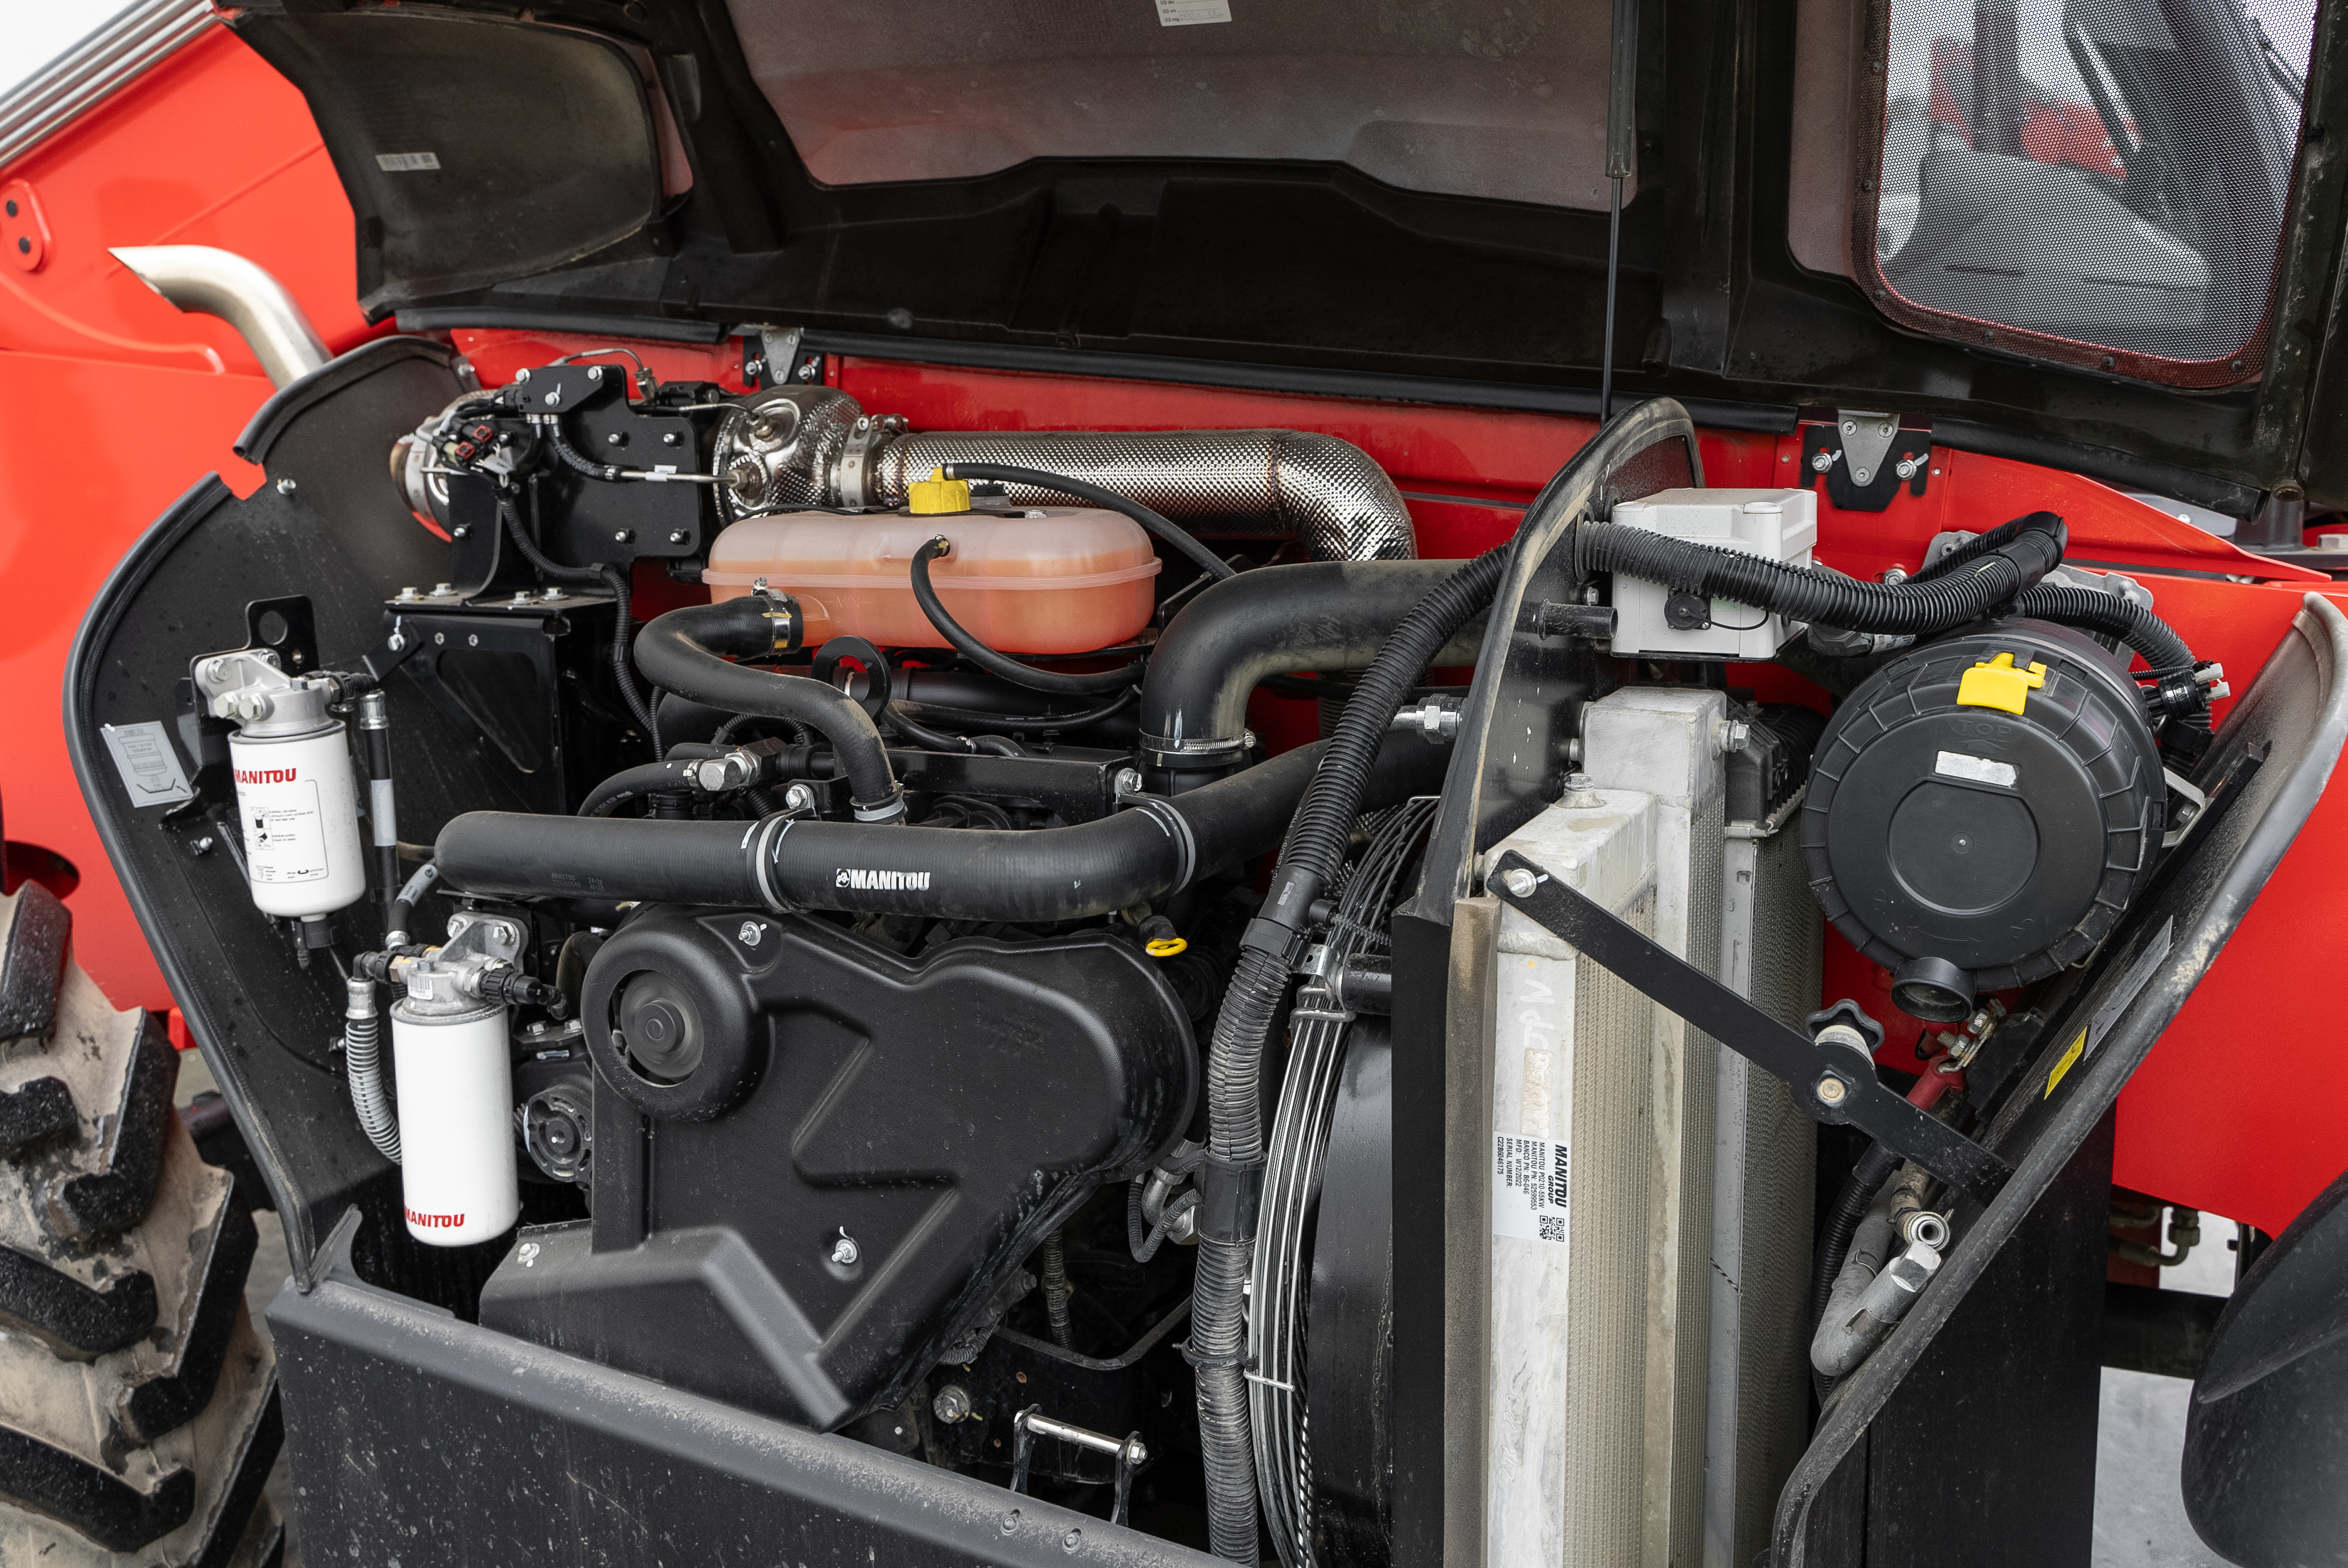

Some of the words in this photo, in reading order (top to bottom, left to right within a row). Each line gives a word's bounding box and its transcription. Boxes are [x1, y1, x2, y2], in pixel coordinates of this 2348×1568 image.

[1958, 719, 2013, 737] TOP
[851, 868, 931, 891] MANITOU
[1554, 1144, 1568, 1208] MANITOU
